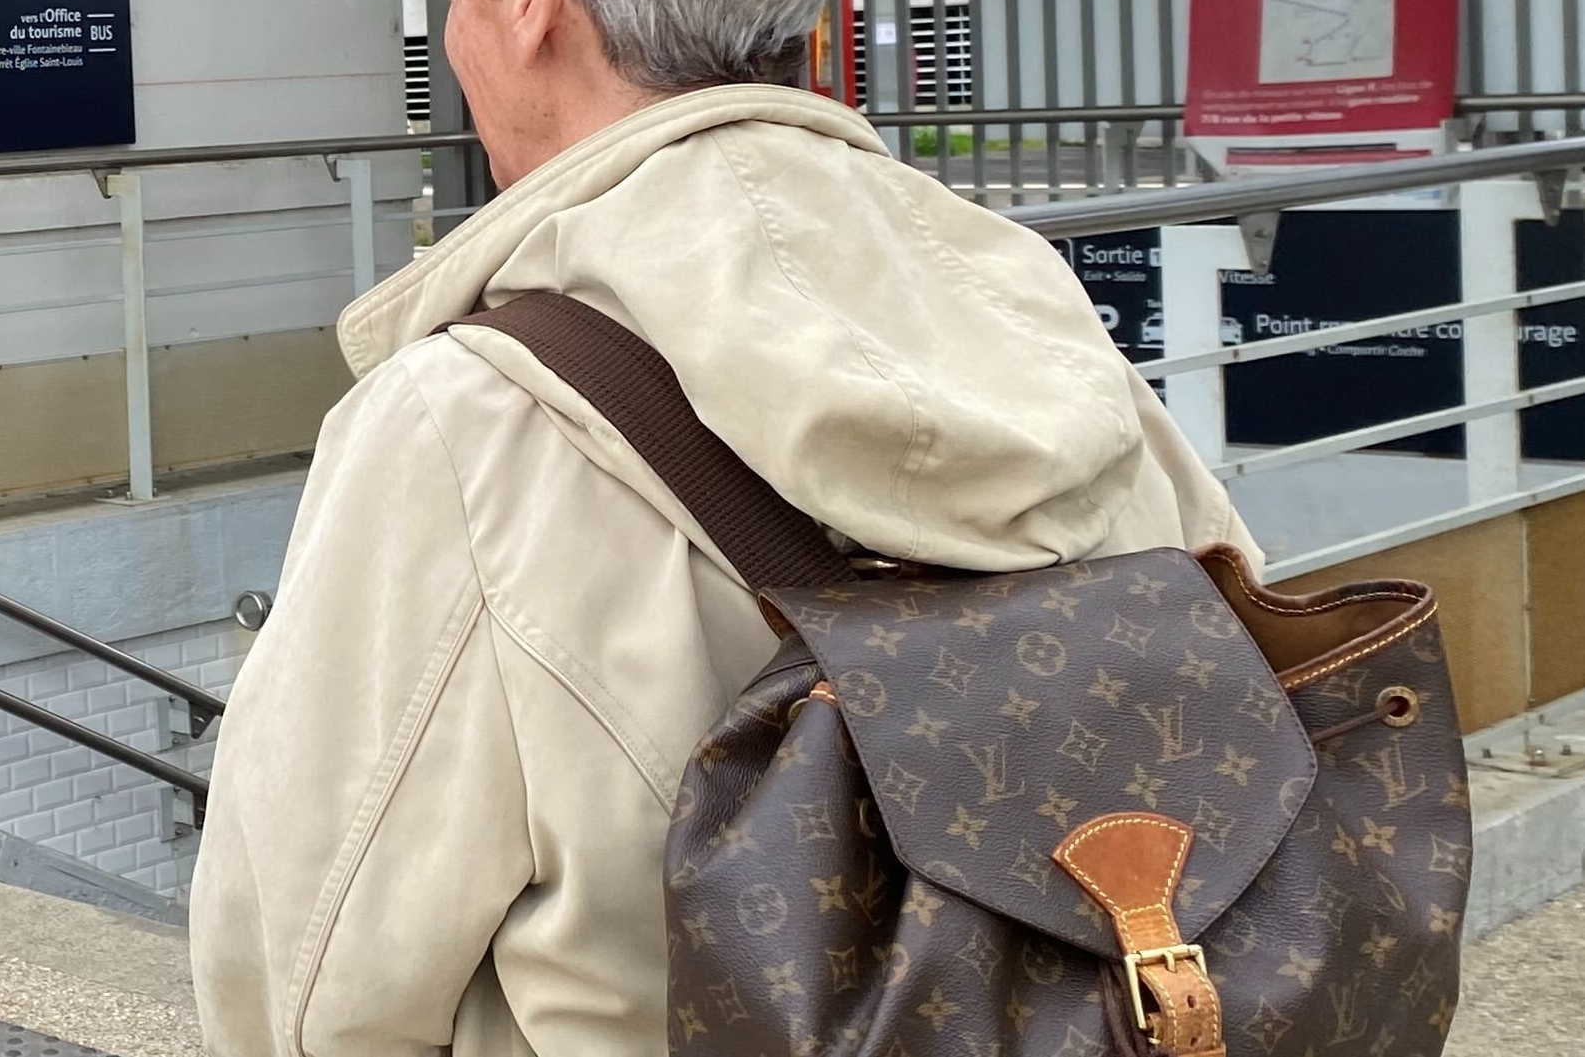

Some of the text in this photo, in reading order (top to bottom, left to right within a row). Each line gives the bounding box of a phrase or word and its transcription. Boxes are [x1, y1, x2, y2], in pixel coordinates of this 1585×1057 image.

[21, 8, 82, 23] vers l'Office
[10, 25, 82, 40] du tourisme
[90, 25, 113, 40] BUS
[27, 43, 83, 54] Fontainebleau
[39, 56, 84, 68] Saint-Louis
[1082, 245, 1144, 264] Sortie
[1084, 271, 1104, 281] Exit
[1256, 313, 1313, 335] Point
